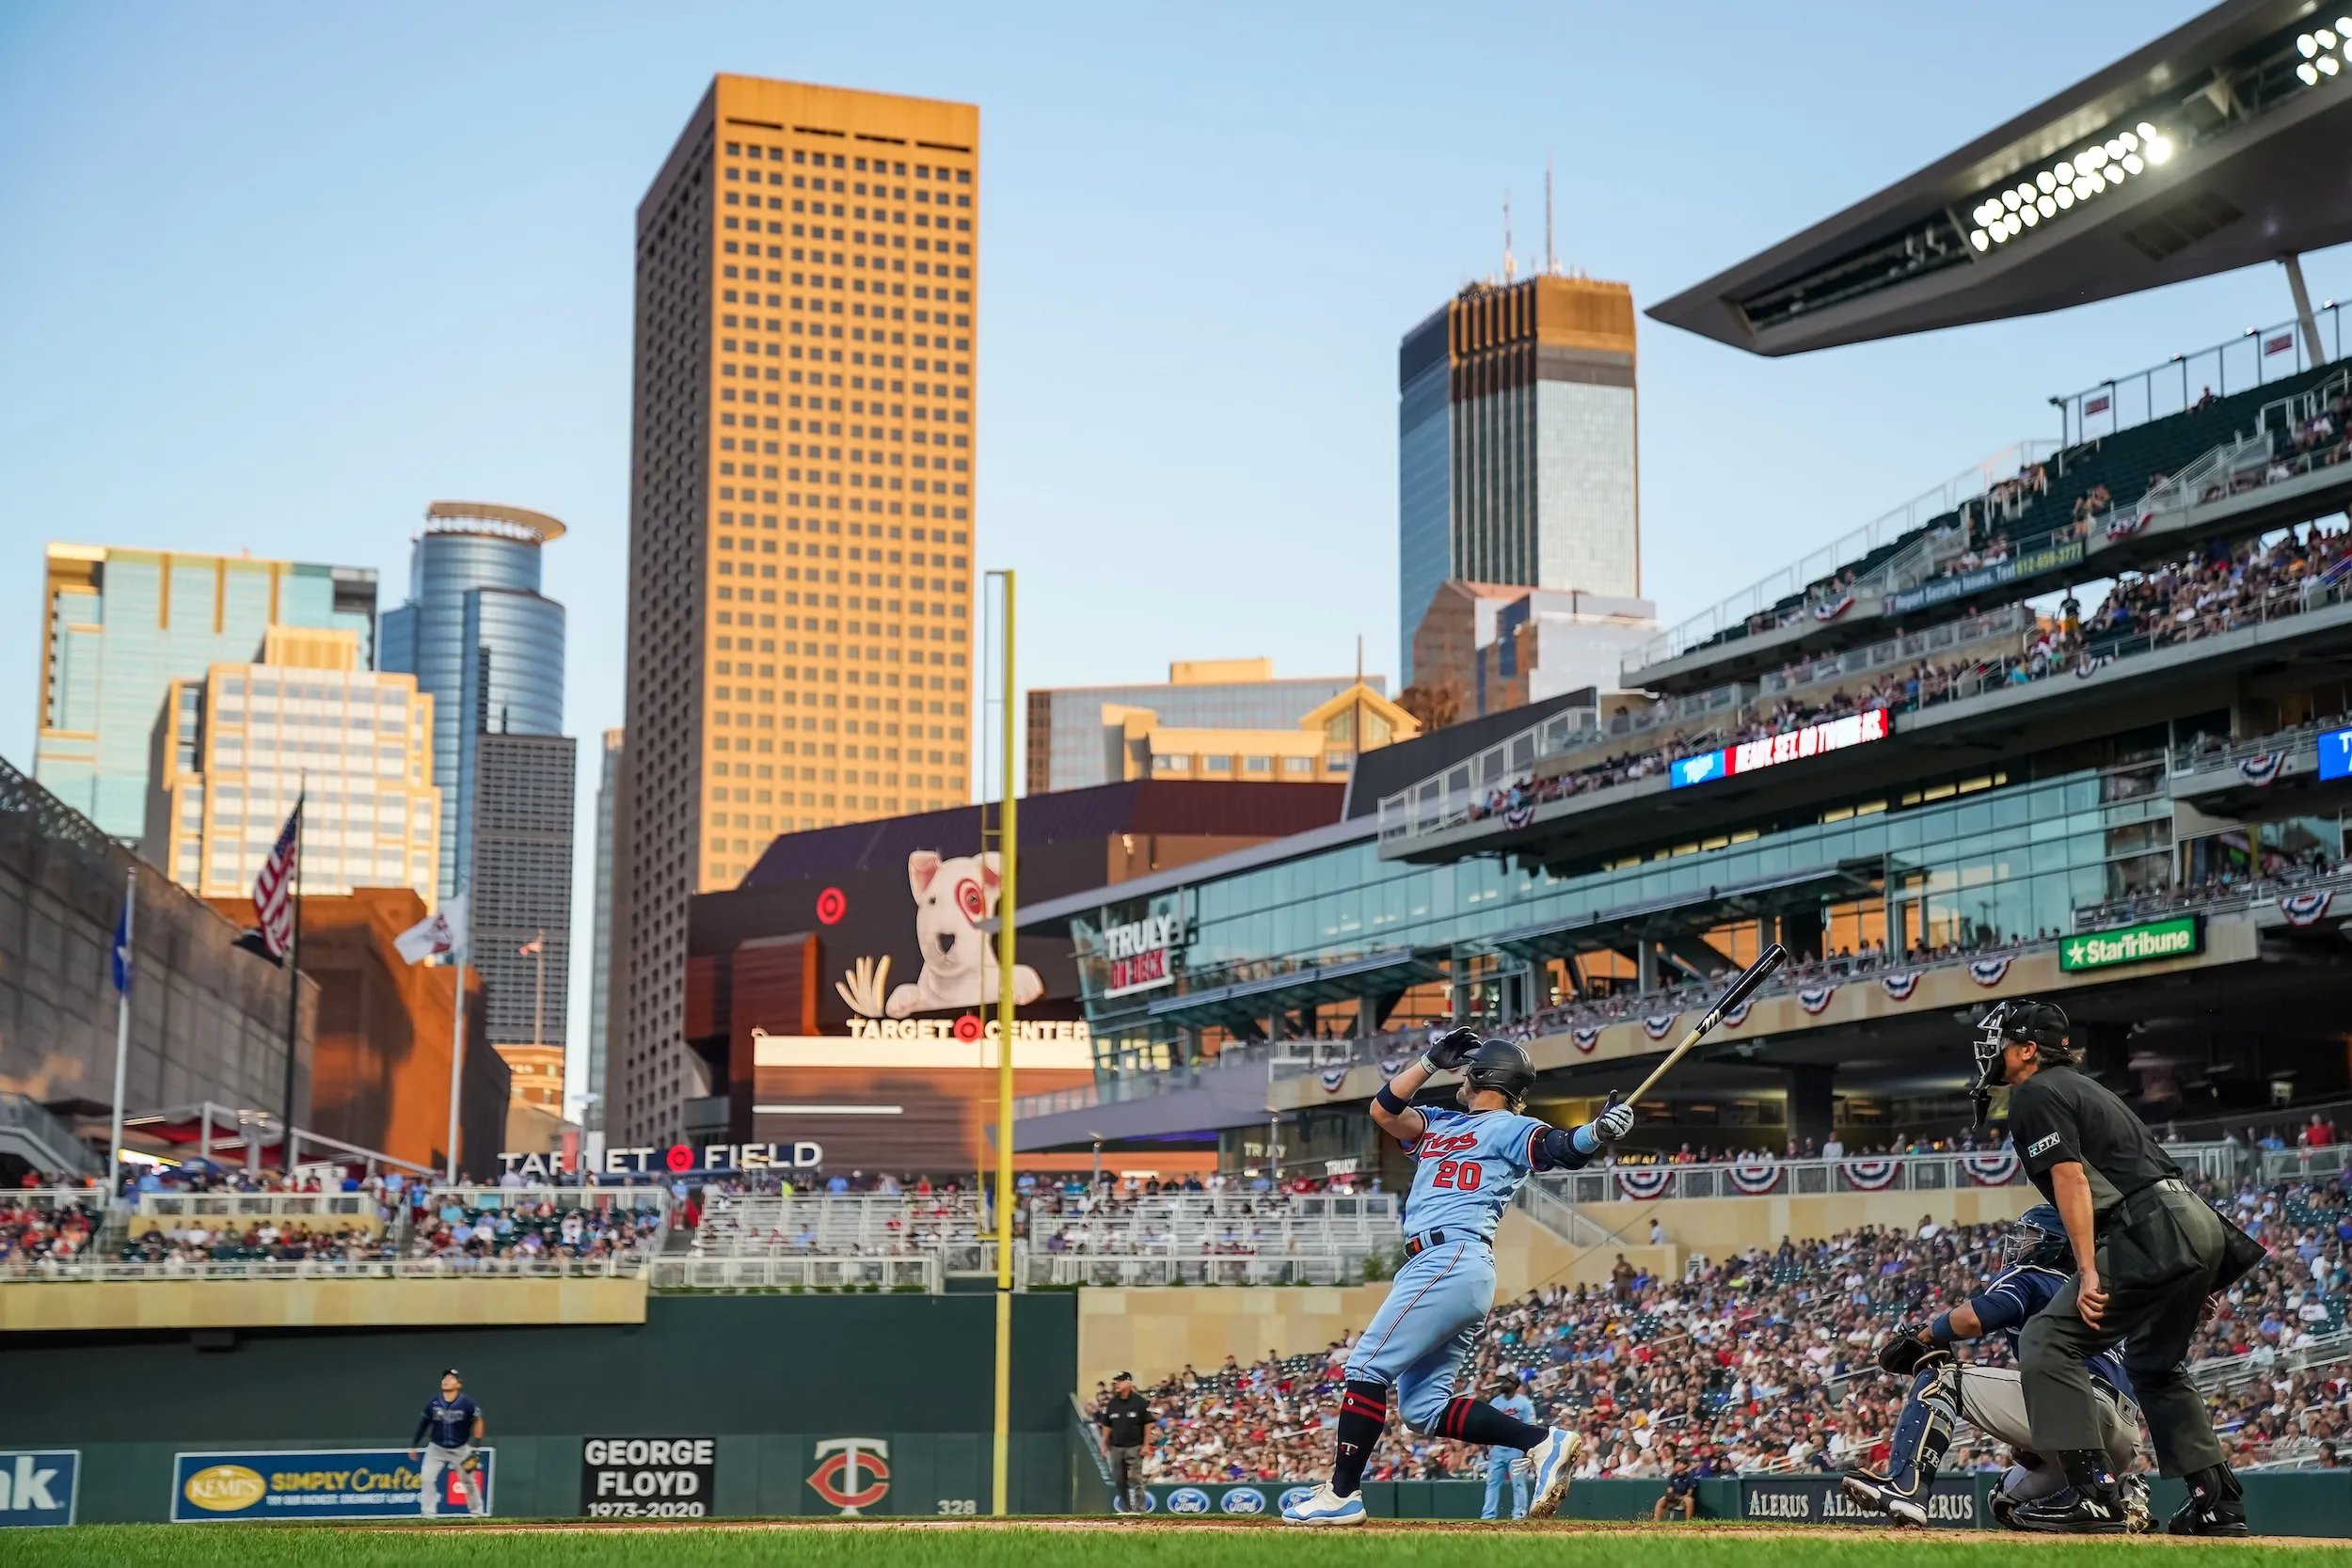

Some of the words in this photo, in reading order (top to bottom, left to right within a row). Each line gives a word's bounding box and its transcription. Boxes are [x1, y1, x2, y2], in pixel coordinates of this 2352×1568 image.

[1104, 913, 1171, 960] TRULY
[2086, 929, 2190, 964] StarTribune
[847, 1018, 954, 1039] TARGET
[2038, 1132, 2058, 1151] FTX
[497, 1147, 656, 1177] TARET
[704, 1141, 824, 1171] FIELD
[1433, 1160, 1482, 1191] 20
[584, 1439, 715, 1465] GEORGE
[271, 1470, 350, 1492] SIMPLY
[351, 1465, 421, 1492] Crafte
[596, 1470, 700, 1497] FLOYD
[587, 1501, 706, 1517] 1973-2020
[937, 1499, 977, 1516] 328
[1174, 1493, 1202, 1513] Ford
[1229, 1493, 1258, 1513] Ford
[1748, 1489, 1809, 1518] ALERUS
[1822, 1489, 1886, 1518] ALE
[1928, 1494, 1974, 1521] ERUS
